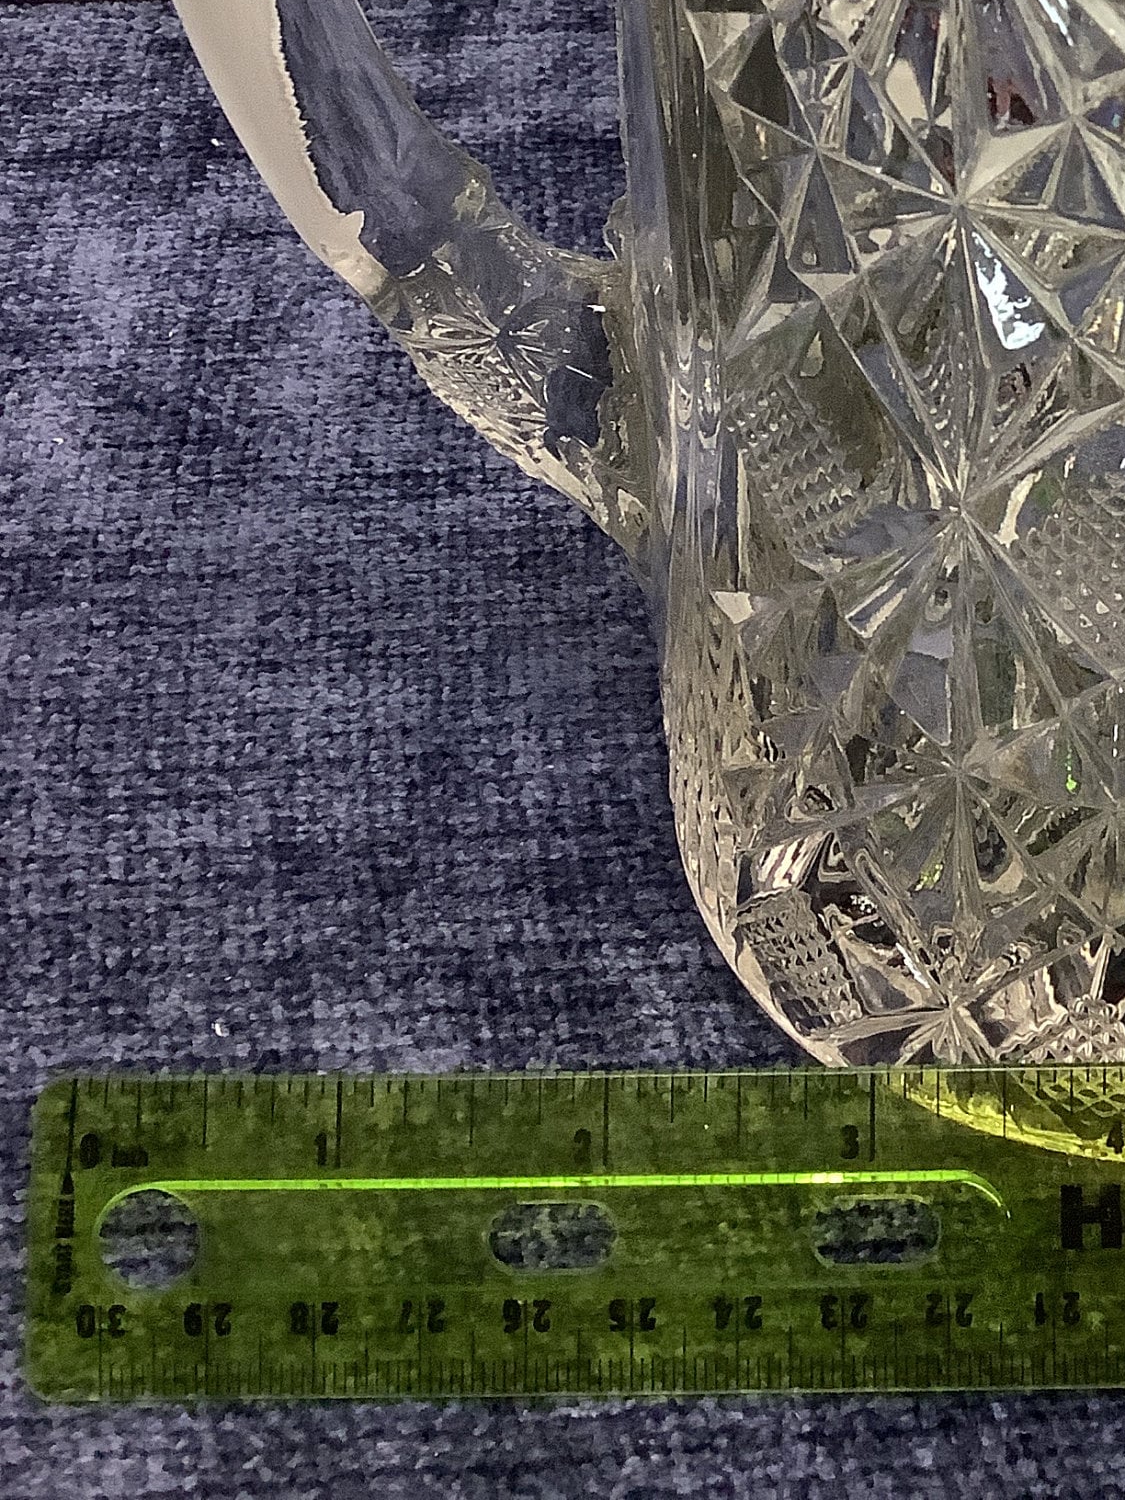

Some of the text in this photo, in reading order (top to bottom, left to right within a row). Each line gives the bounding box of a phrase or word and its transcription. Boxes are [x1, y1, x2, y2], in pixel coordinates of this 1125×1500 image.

[314, 1132, 328, 1167] 1
[574, 1128, 592, 1165] 2
[840, 1124, 859, 1160] 3
[1106, 1120, 1125, 1155] 4
[75, 1304, 127, 1338] 30
[183, 1302, 232, 1337] 29
[289, 1301, 339, 1335] 28
[402, 1300, 445, 1333] 27
[502, 1299, 552, 1334] 26
[609, 1298, 657, 1332] 25
[713, 1297, 762, 1331] 24
[819, 1296, 869, 1330] 23
[925, 1294, 973, 1328] 22
[1035, 1292, 1081, 1326] 21
